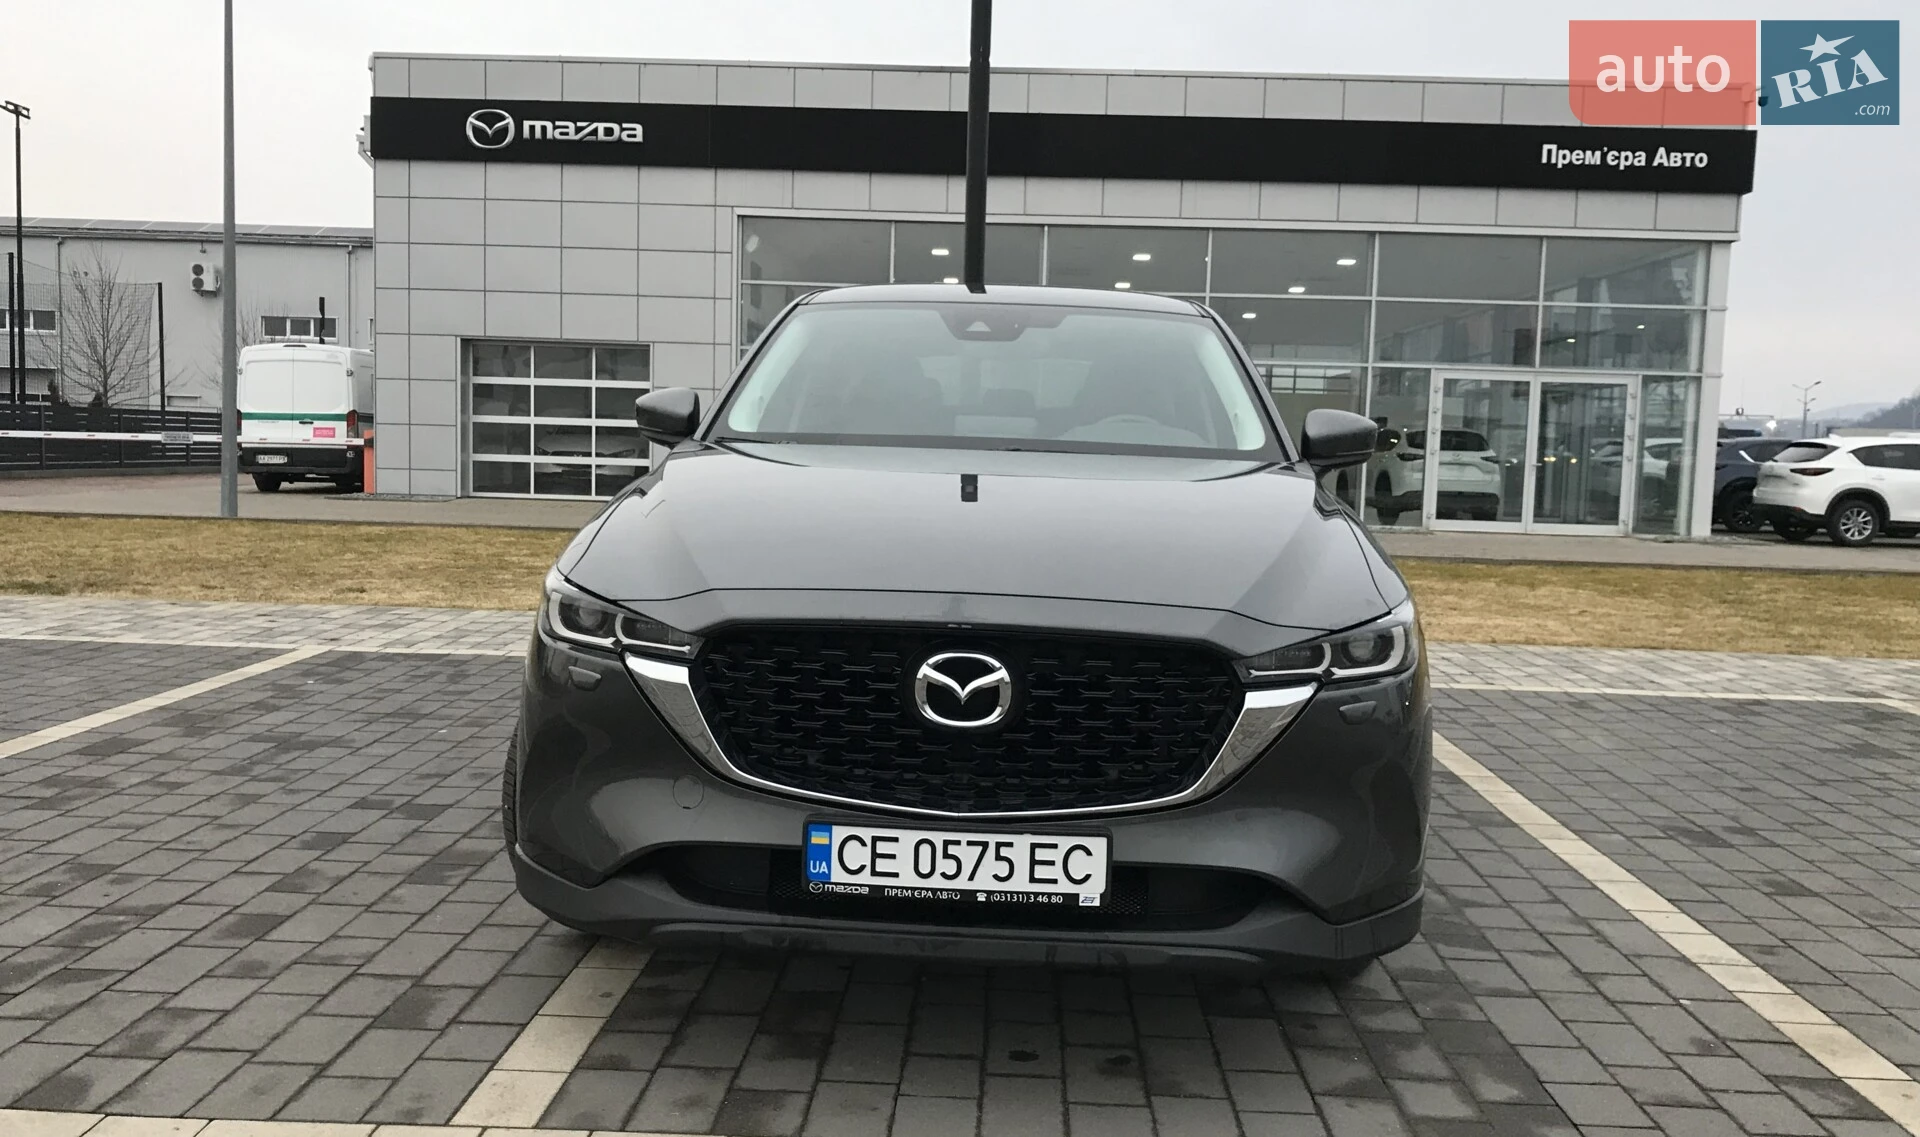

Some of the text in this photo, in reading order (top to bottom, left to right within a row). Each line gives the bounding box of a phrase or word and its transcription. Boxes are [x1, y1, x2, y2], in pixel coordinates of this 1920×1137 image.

[523, 119, 644, 143] mazda
[1652, 147, 1709, 169] Авто
[810, 860, 829, 875] UA
[837, 834, 1094, 886] CE 0575 EC
[824, 883, 870, 895] mazda
[990, 893, 1063, 904] (03131) 3 46 80
